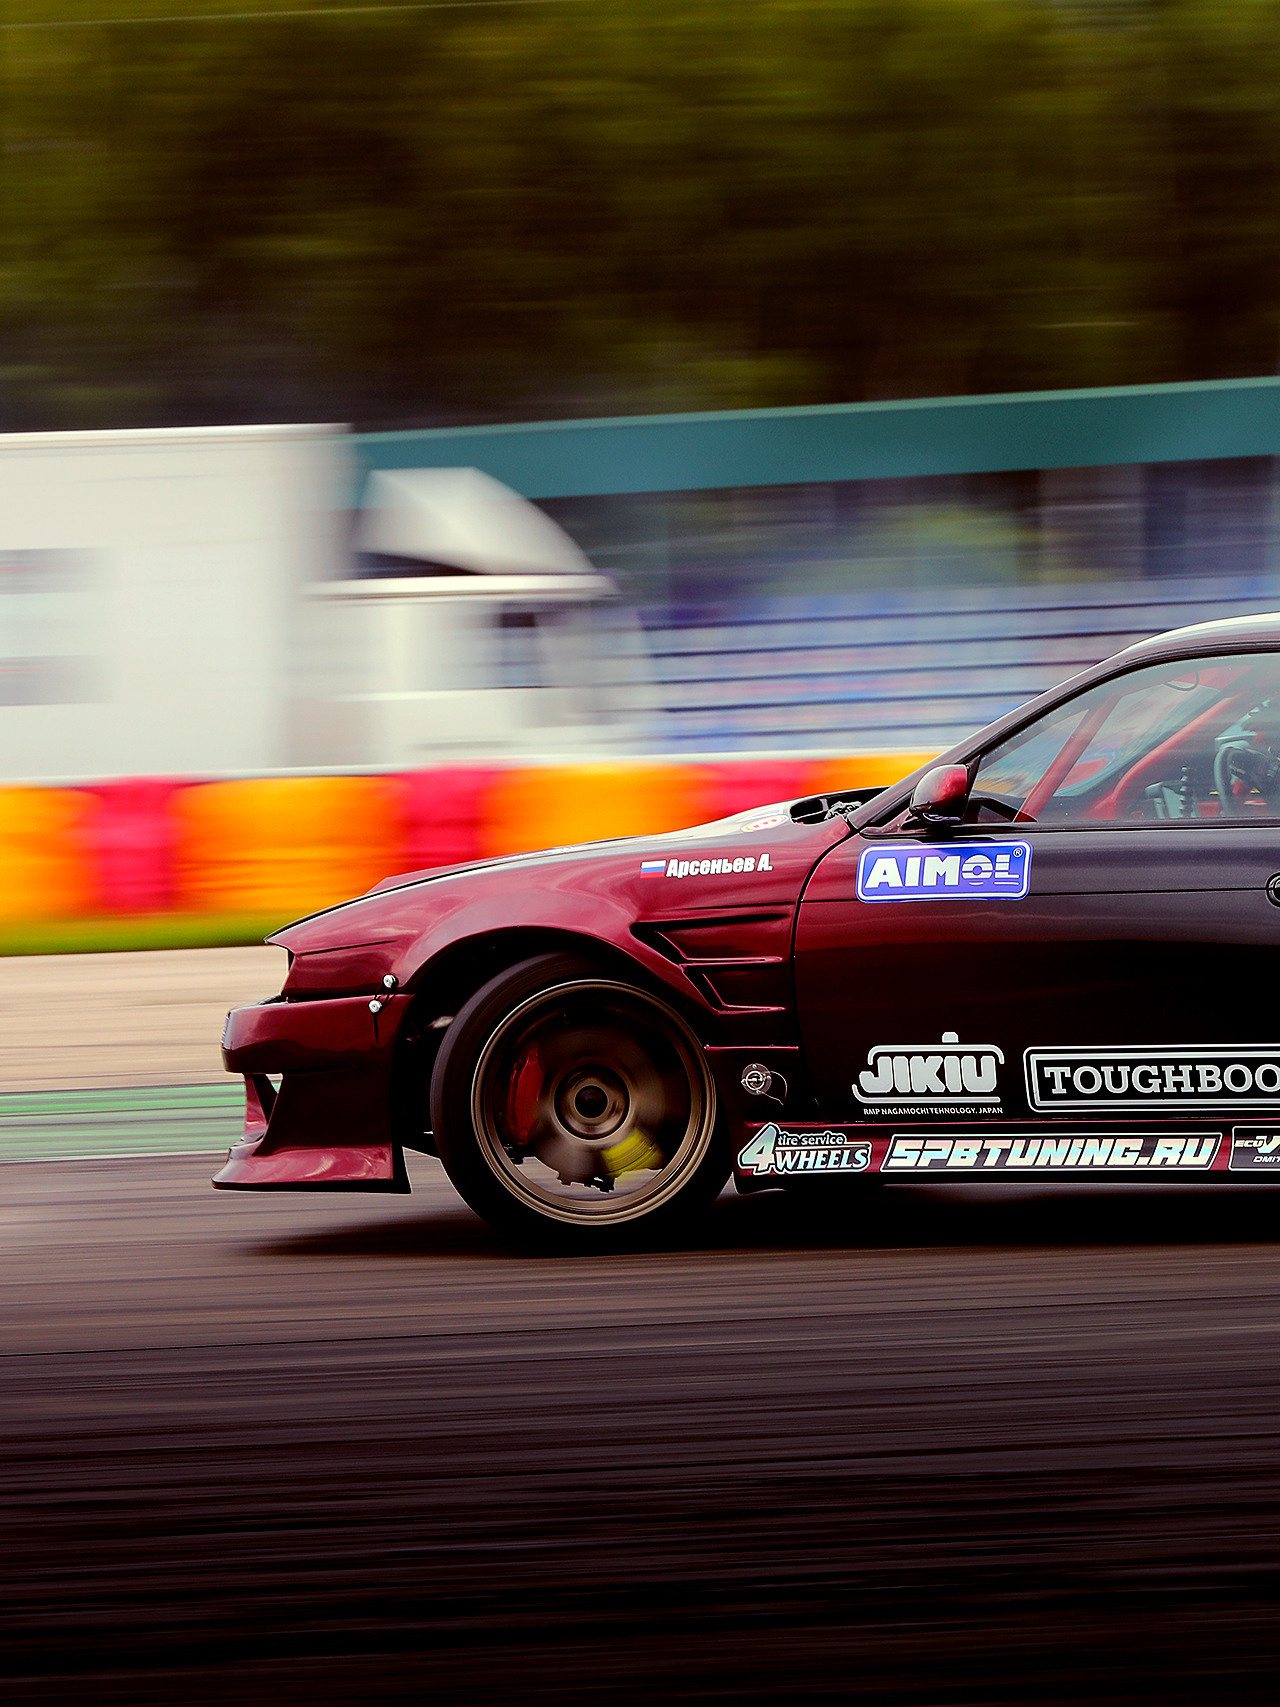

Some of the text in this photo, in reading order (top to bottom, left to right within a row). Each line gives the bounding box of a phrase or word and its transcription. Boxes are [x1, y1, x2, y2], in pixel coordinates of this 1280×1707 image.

[665, 857, 756, 879] Арсеньев
[864, 854, 1020, 888] AIMOL
[859, 1056, 997, 1093] JIKIU
[863, 1107, 881, 1116] RMP
[979, 1106, 1004, 1115] JAPAN
[741, 1125, 869, 1172] 4 WHEELS
[777, 1134, 844, 1146] tire service
[1234, 1139, 1264, 1148] ECU
